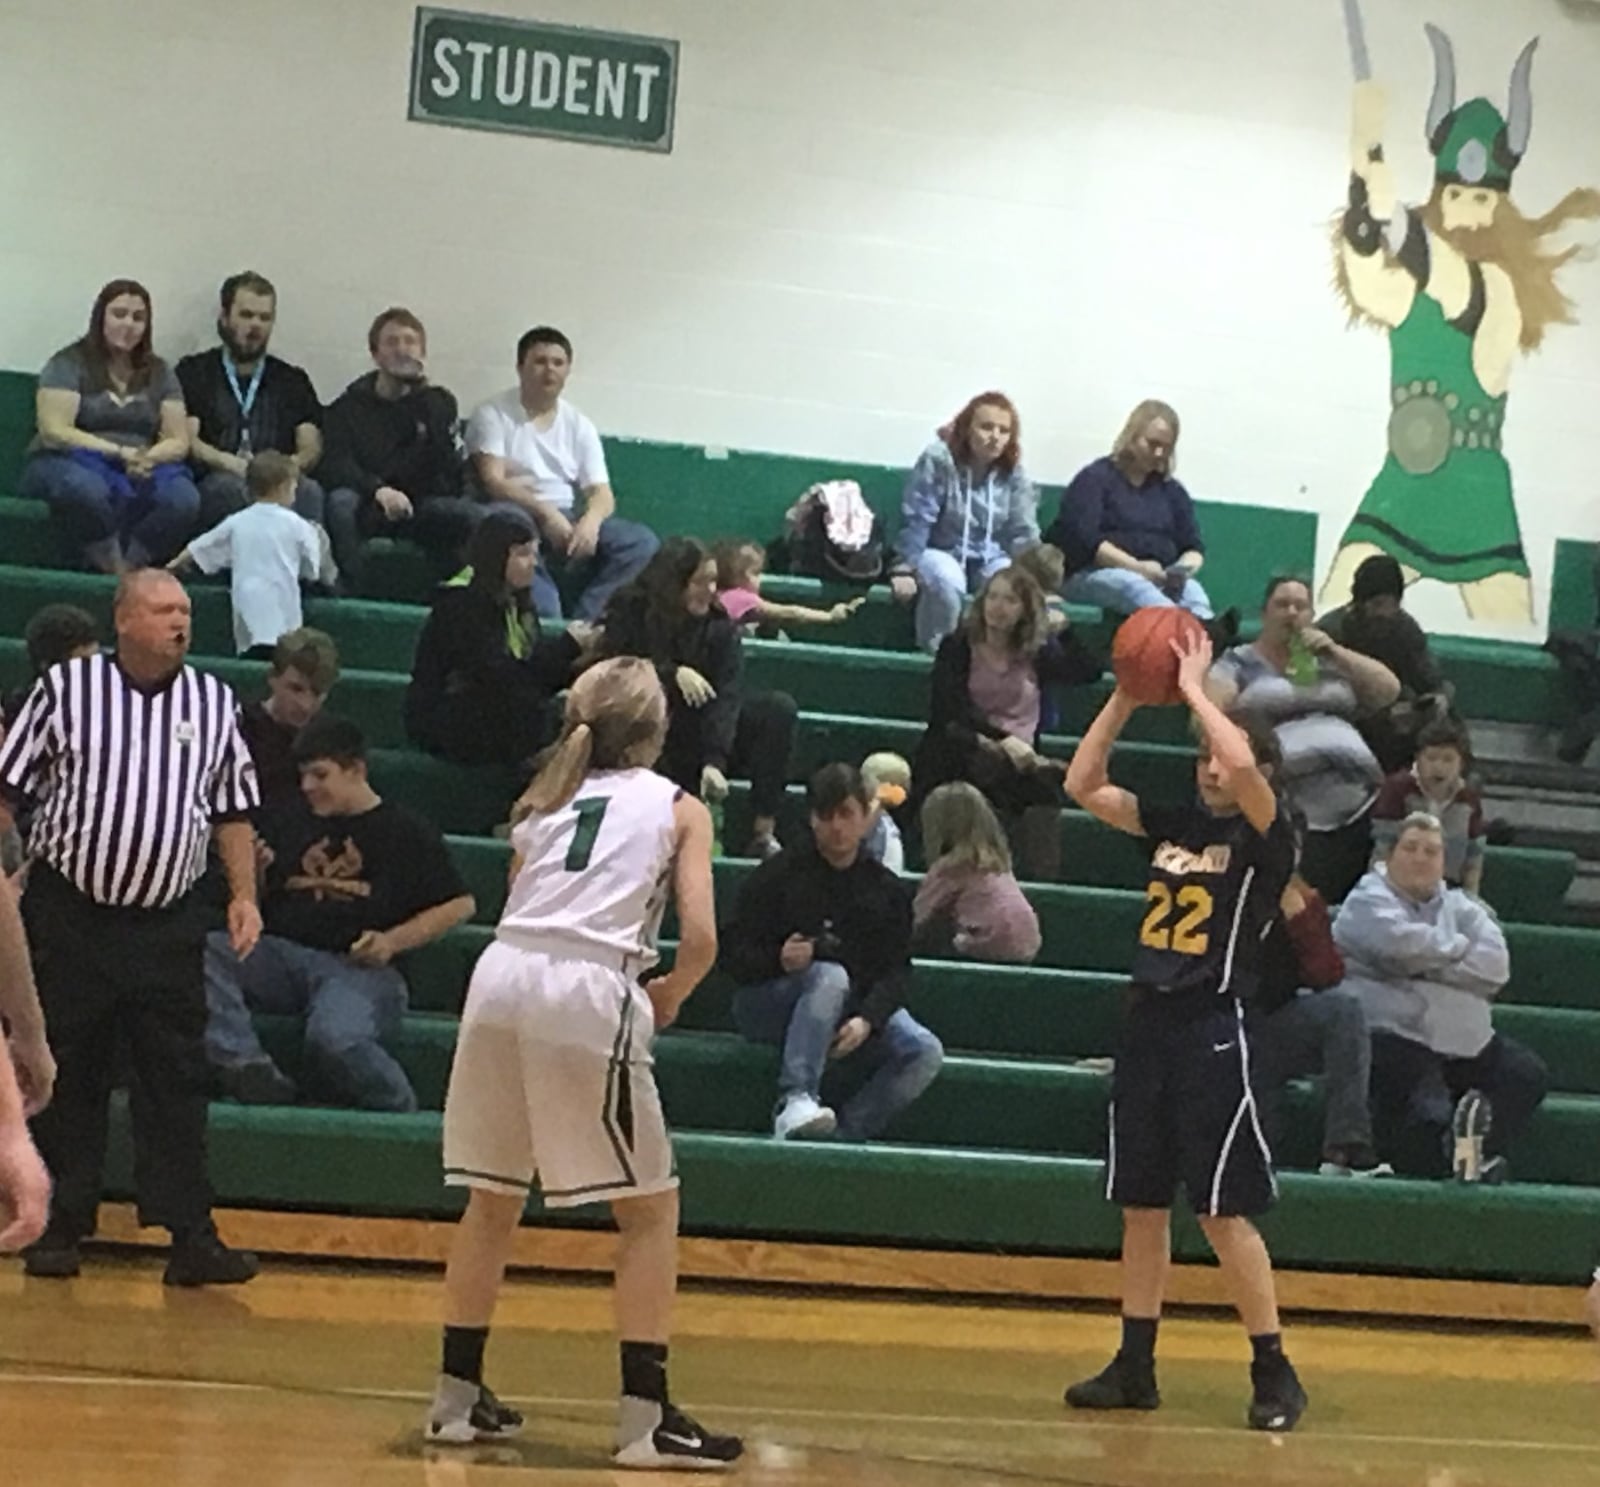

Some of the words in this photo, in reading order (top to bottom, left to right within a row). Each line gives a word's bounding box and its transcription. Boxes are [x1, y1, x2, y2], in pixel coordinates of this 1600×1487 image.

[432, 38, 660, 123] STUDENT
[565, 798, 612, 872] 1
[1141, 882, 1213, 956] 22
